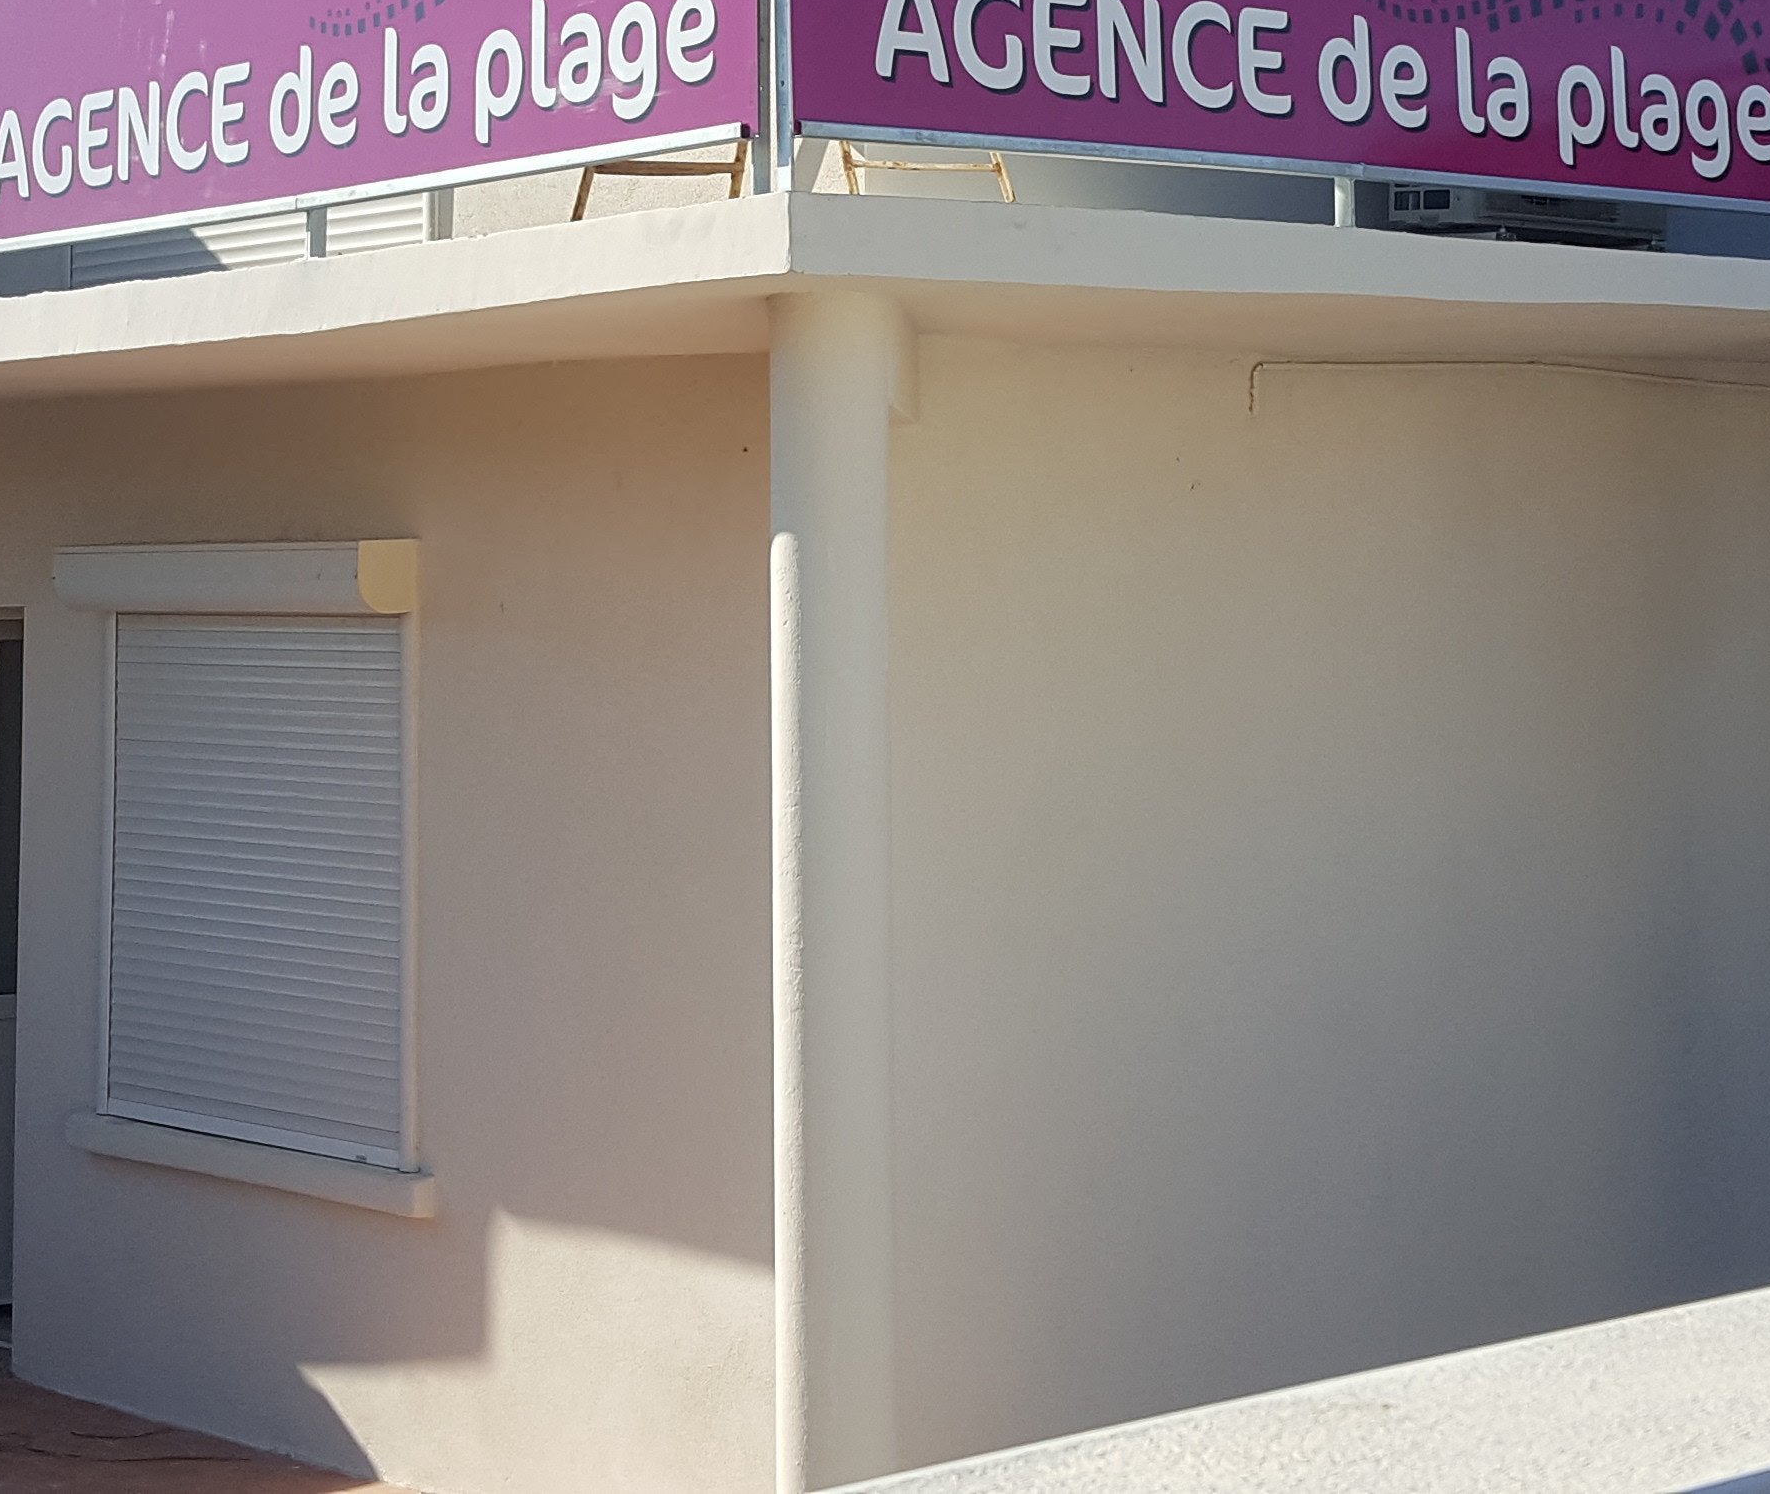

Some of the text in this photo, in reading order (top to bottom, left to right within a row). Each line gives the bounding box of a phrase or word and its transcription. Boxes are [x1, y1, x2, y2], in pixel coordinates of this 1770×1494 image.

[269, 44, 360, 154] de
[383, 27, 451, 134] la
[1318, 14, 1428, 128] de
[1455, 26, 1530, 138] la
